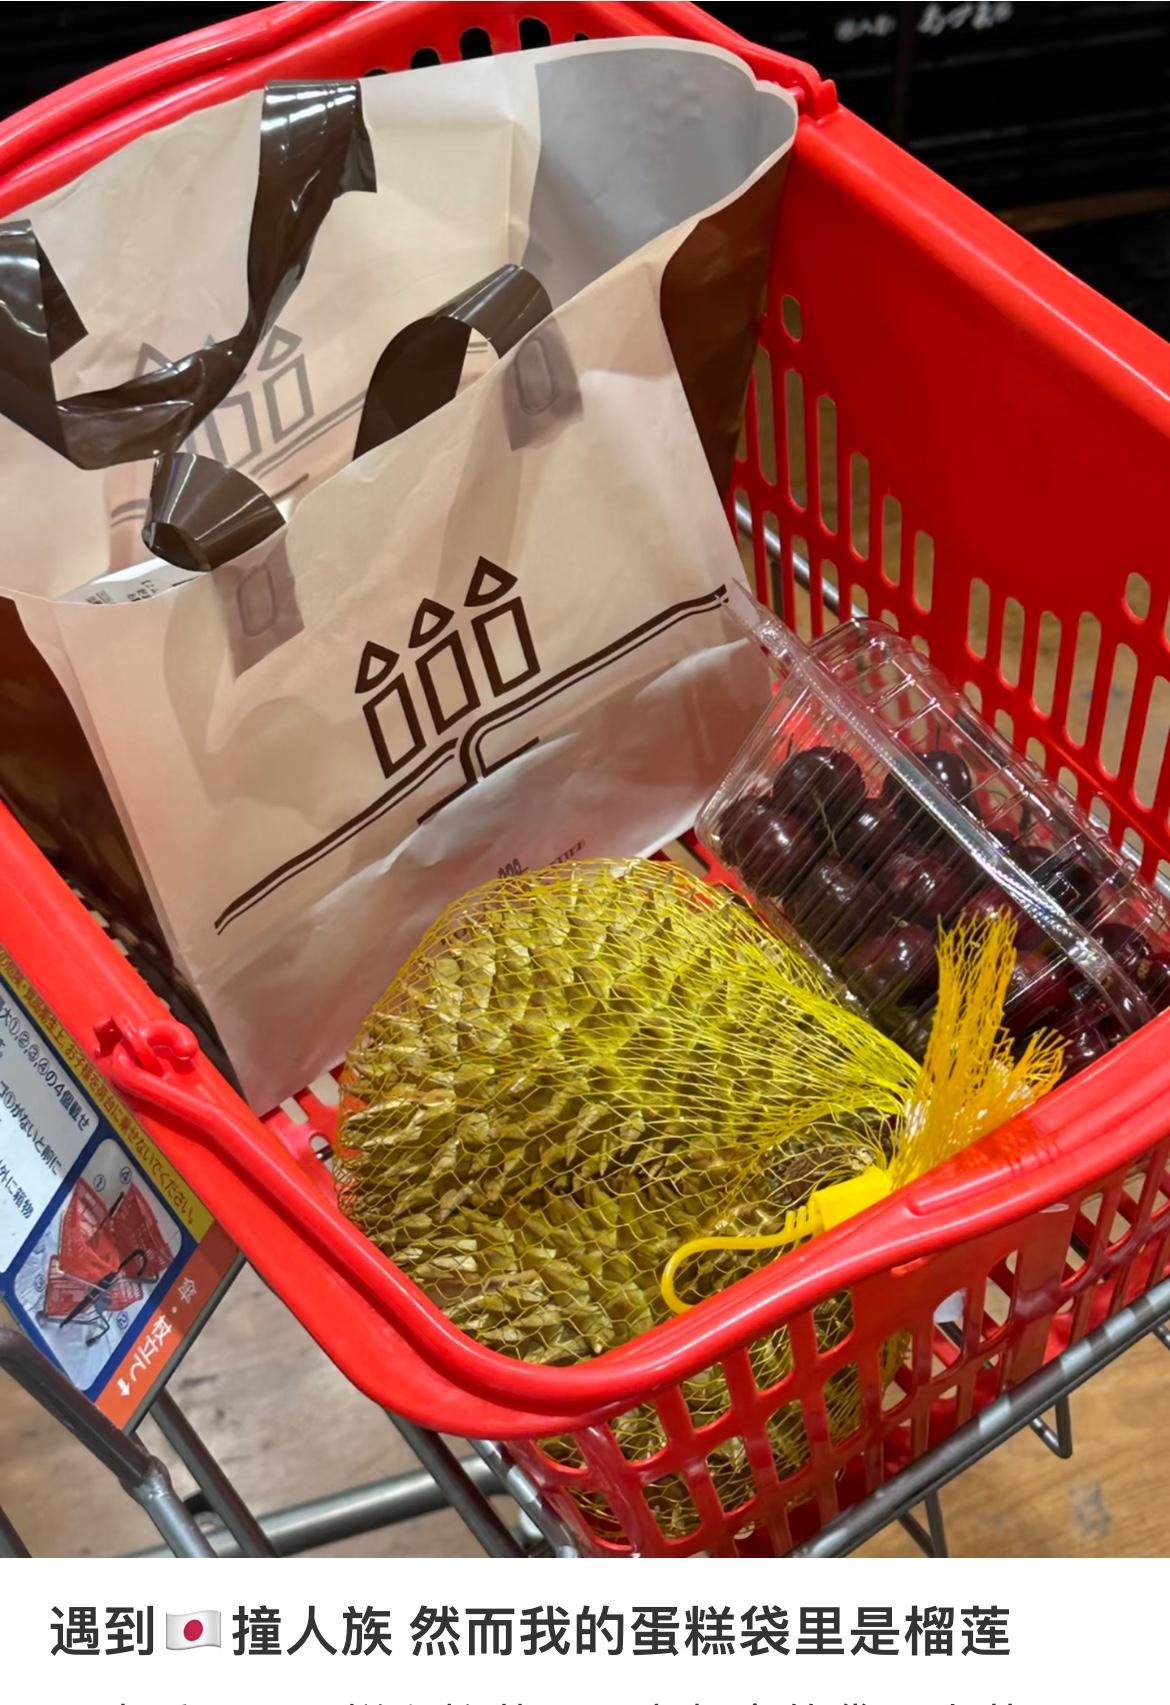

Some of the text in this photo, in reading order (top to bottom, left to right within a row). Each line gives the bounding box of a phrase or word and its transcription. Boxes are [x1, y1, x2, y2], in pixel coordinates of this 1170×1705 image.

[130, 1277, 197, 1382] 傘・杖立て
